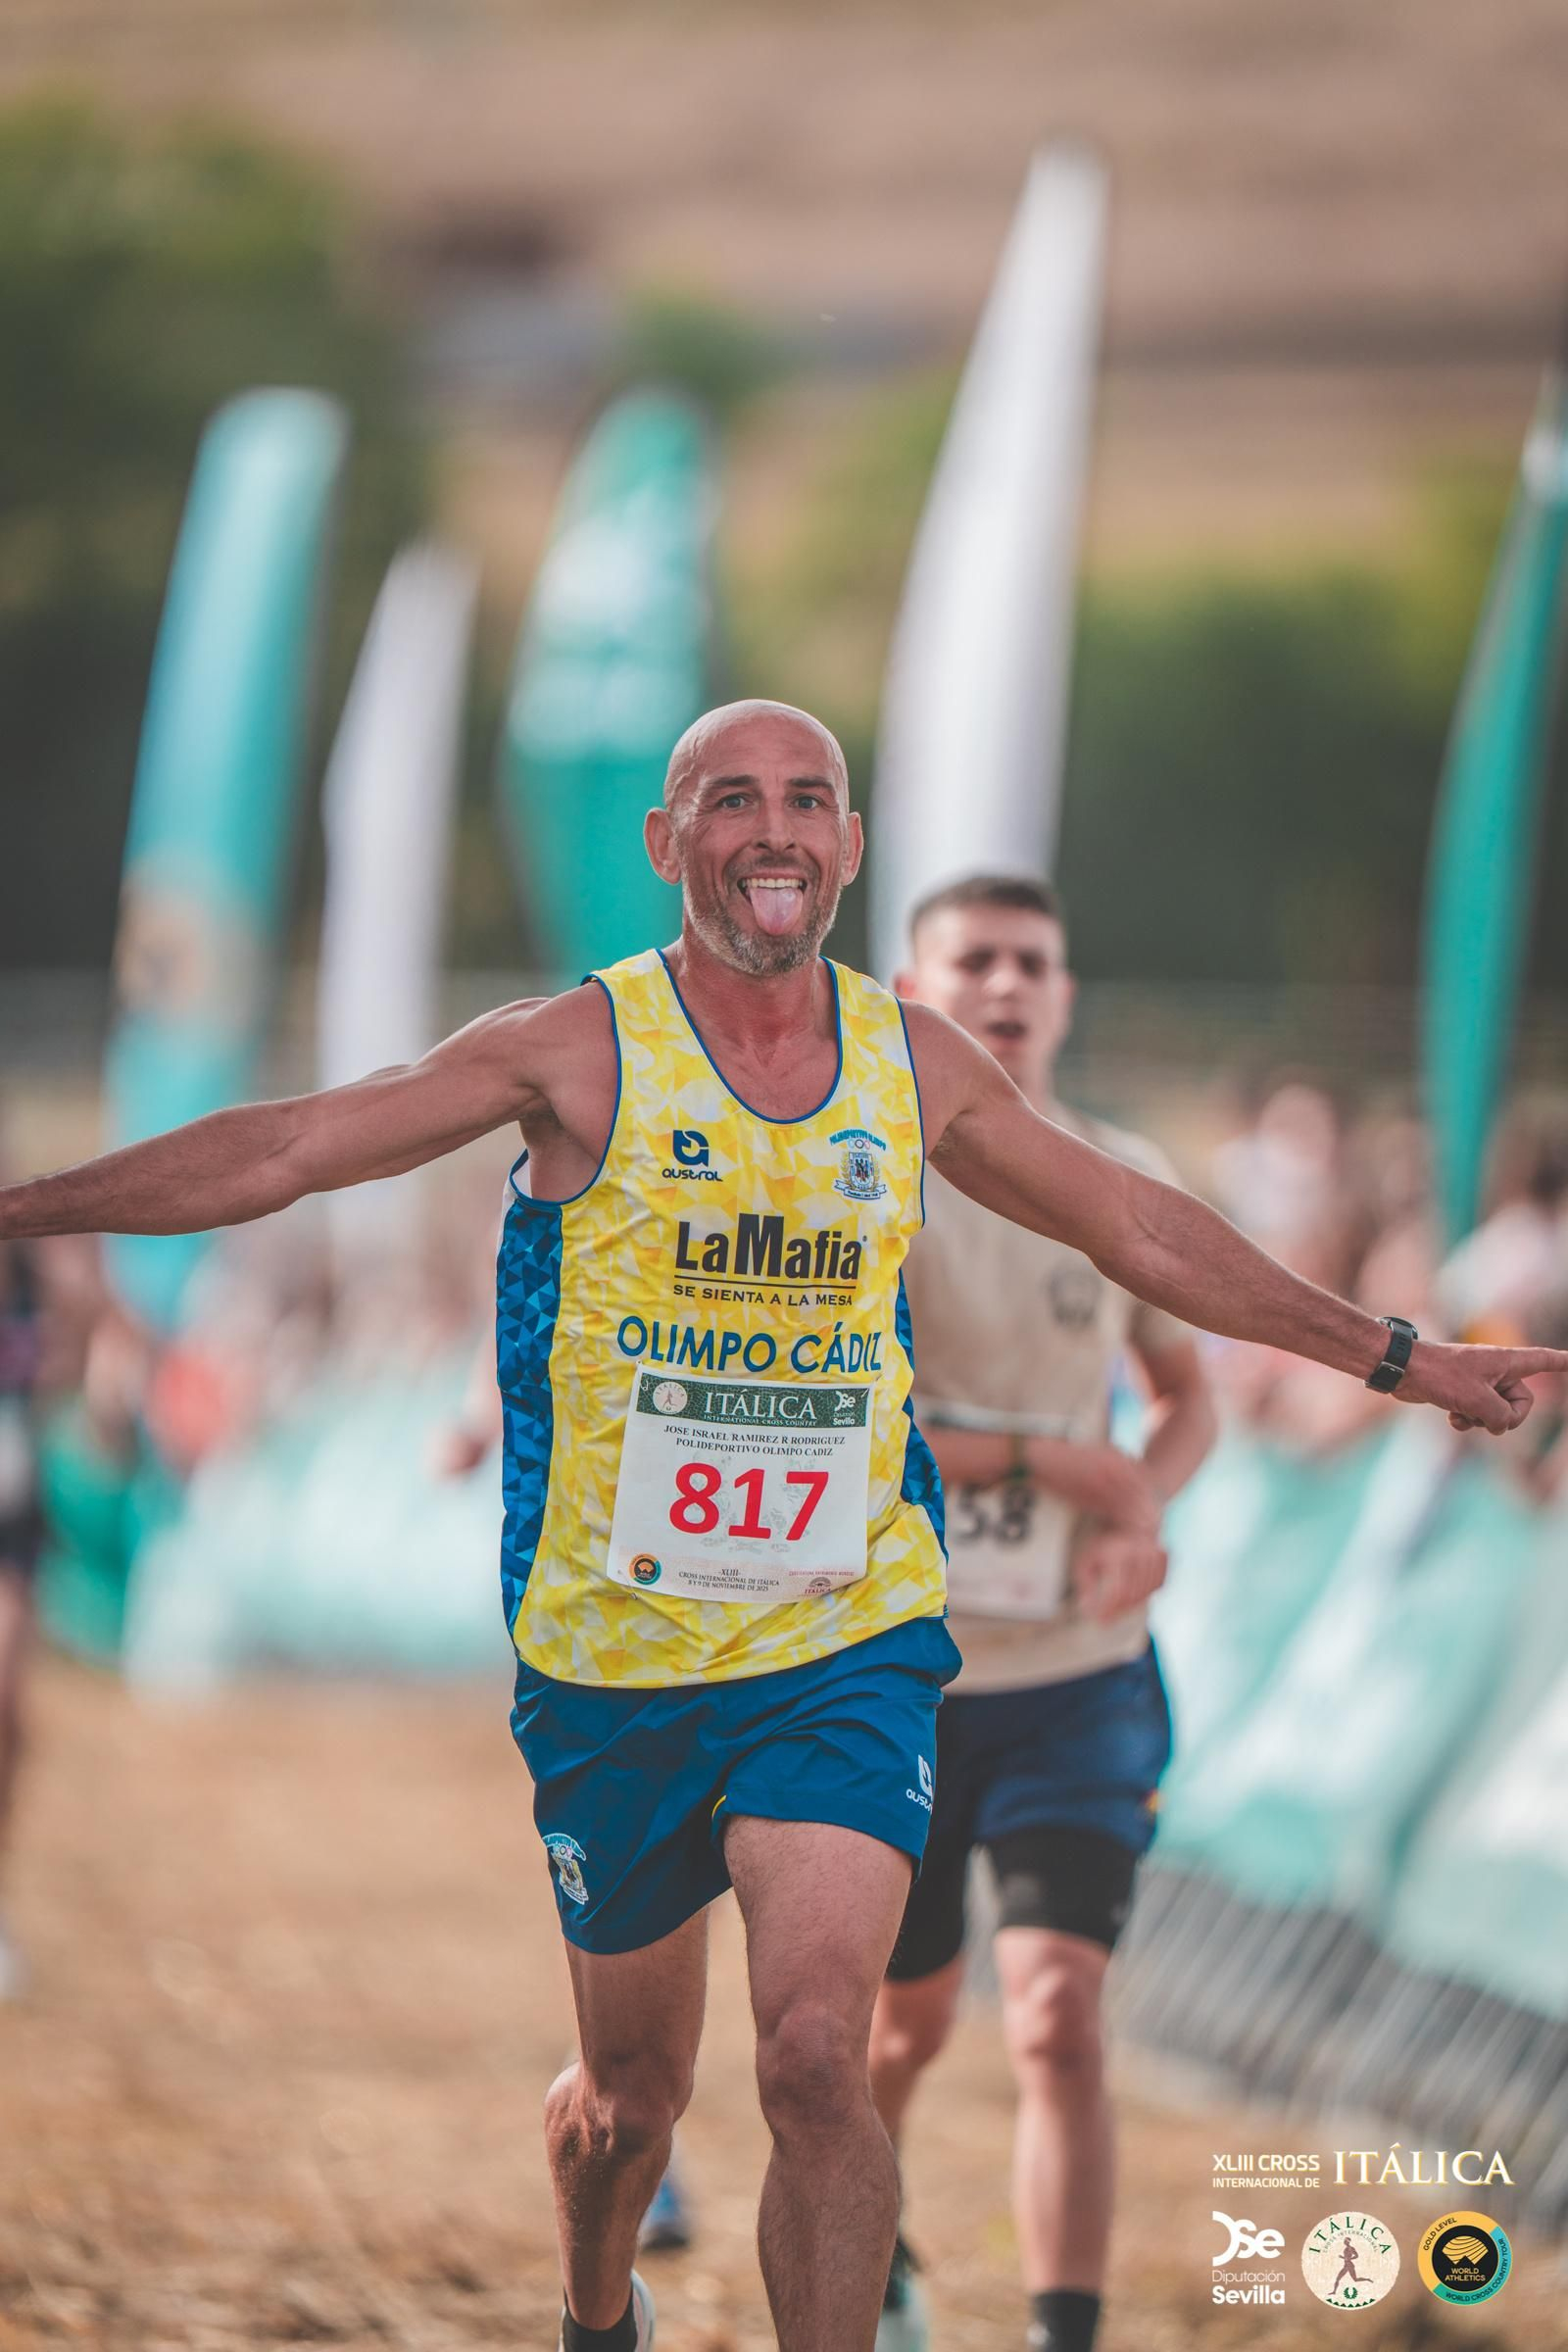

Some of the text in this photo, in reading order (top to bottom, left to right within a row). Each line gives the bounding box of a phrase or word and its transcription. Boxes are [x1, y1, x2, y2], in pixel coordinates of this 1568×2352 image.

[662, 1165, 723, 1182] austral
[673, 1284, 853, 1307] SE SIENTA A LA MESA
[616, 1315, 883, 1374] OLIMPO CÁDIZ
[704, 1389, 817, 1420] ITÁLICA
[704, 1414, 760, 1425] INTERNATIONAL
[663, 1424, 689, 1436] JOSE
[692, 1428, 728, 1442] ISRAEL
[731, 1433, 778, 1445] RAMIREZ
[791, 1436, 846, 1446] RODRIGUEZ
[676, 1437, 833, 1456] POLIDEPORTIVO OLIMPO CADIZ
[668, 1462, 829, 1543] 817
[678, 1571, 698, 1580] CROSS
[699, 1574, 746, 1584] INTERNACIONAL
[711, 1582, 746, 1591] NOVIEMBRE
